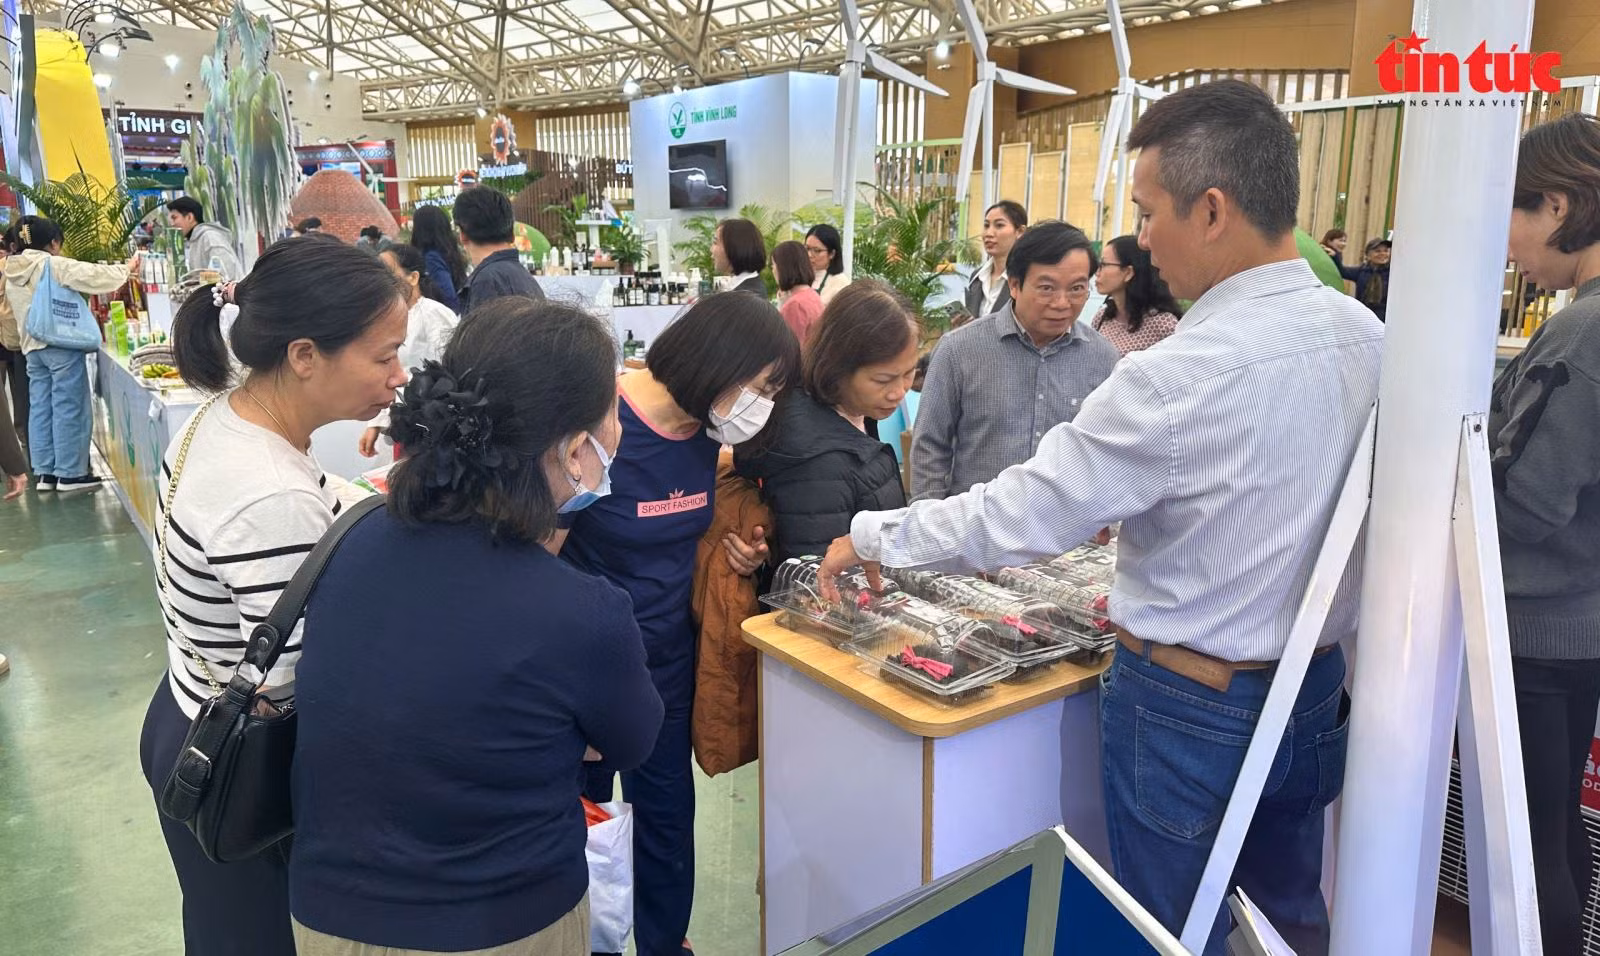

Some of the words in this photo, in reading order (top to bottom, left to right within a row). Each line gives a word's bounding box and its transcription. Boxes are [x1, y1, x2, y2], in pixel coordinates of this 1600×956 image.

[721, 105, 737, 120] LONG
[118, 112, 165, 133] TỈNH
[642, 502, 671, 514] SPORT
[673, 495, 706, 510] FASHION
